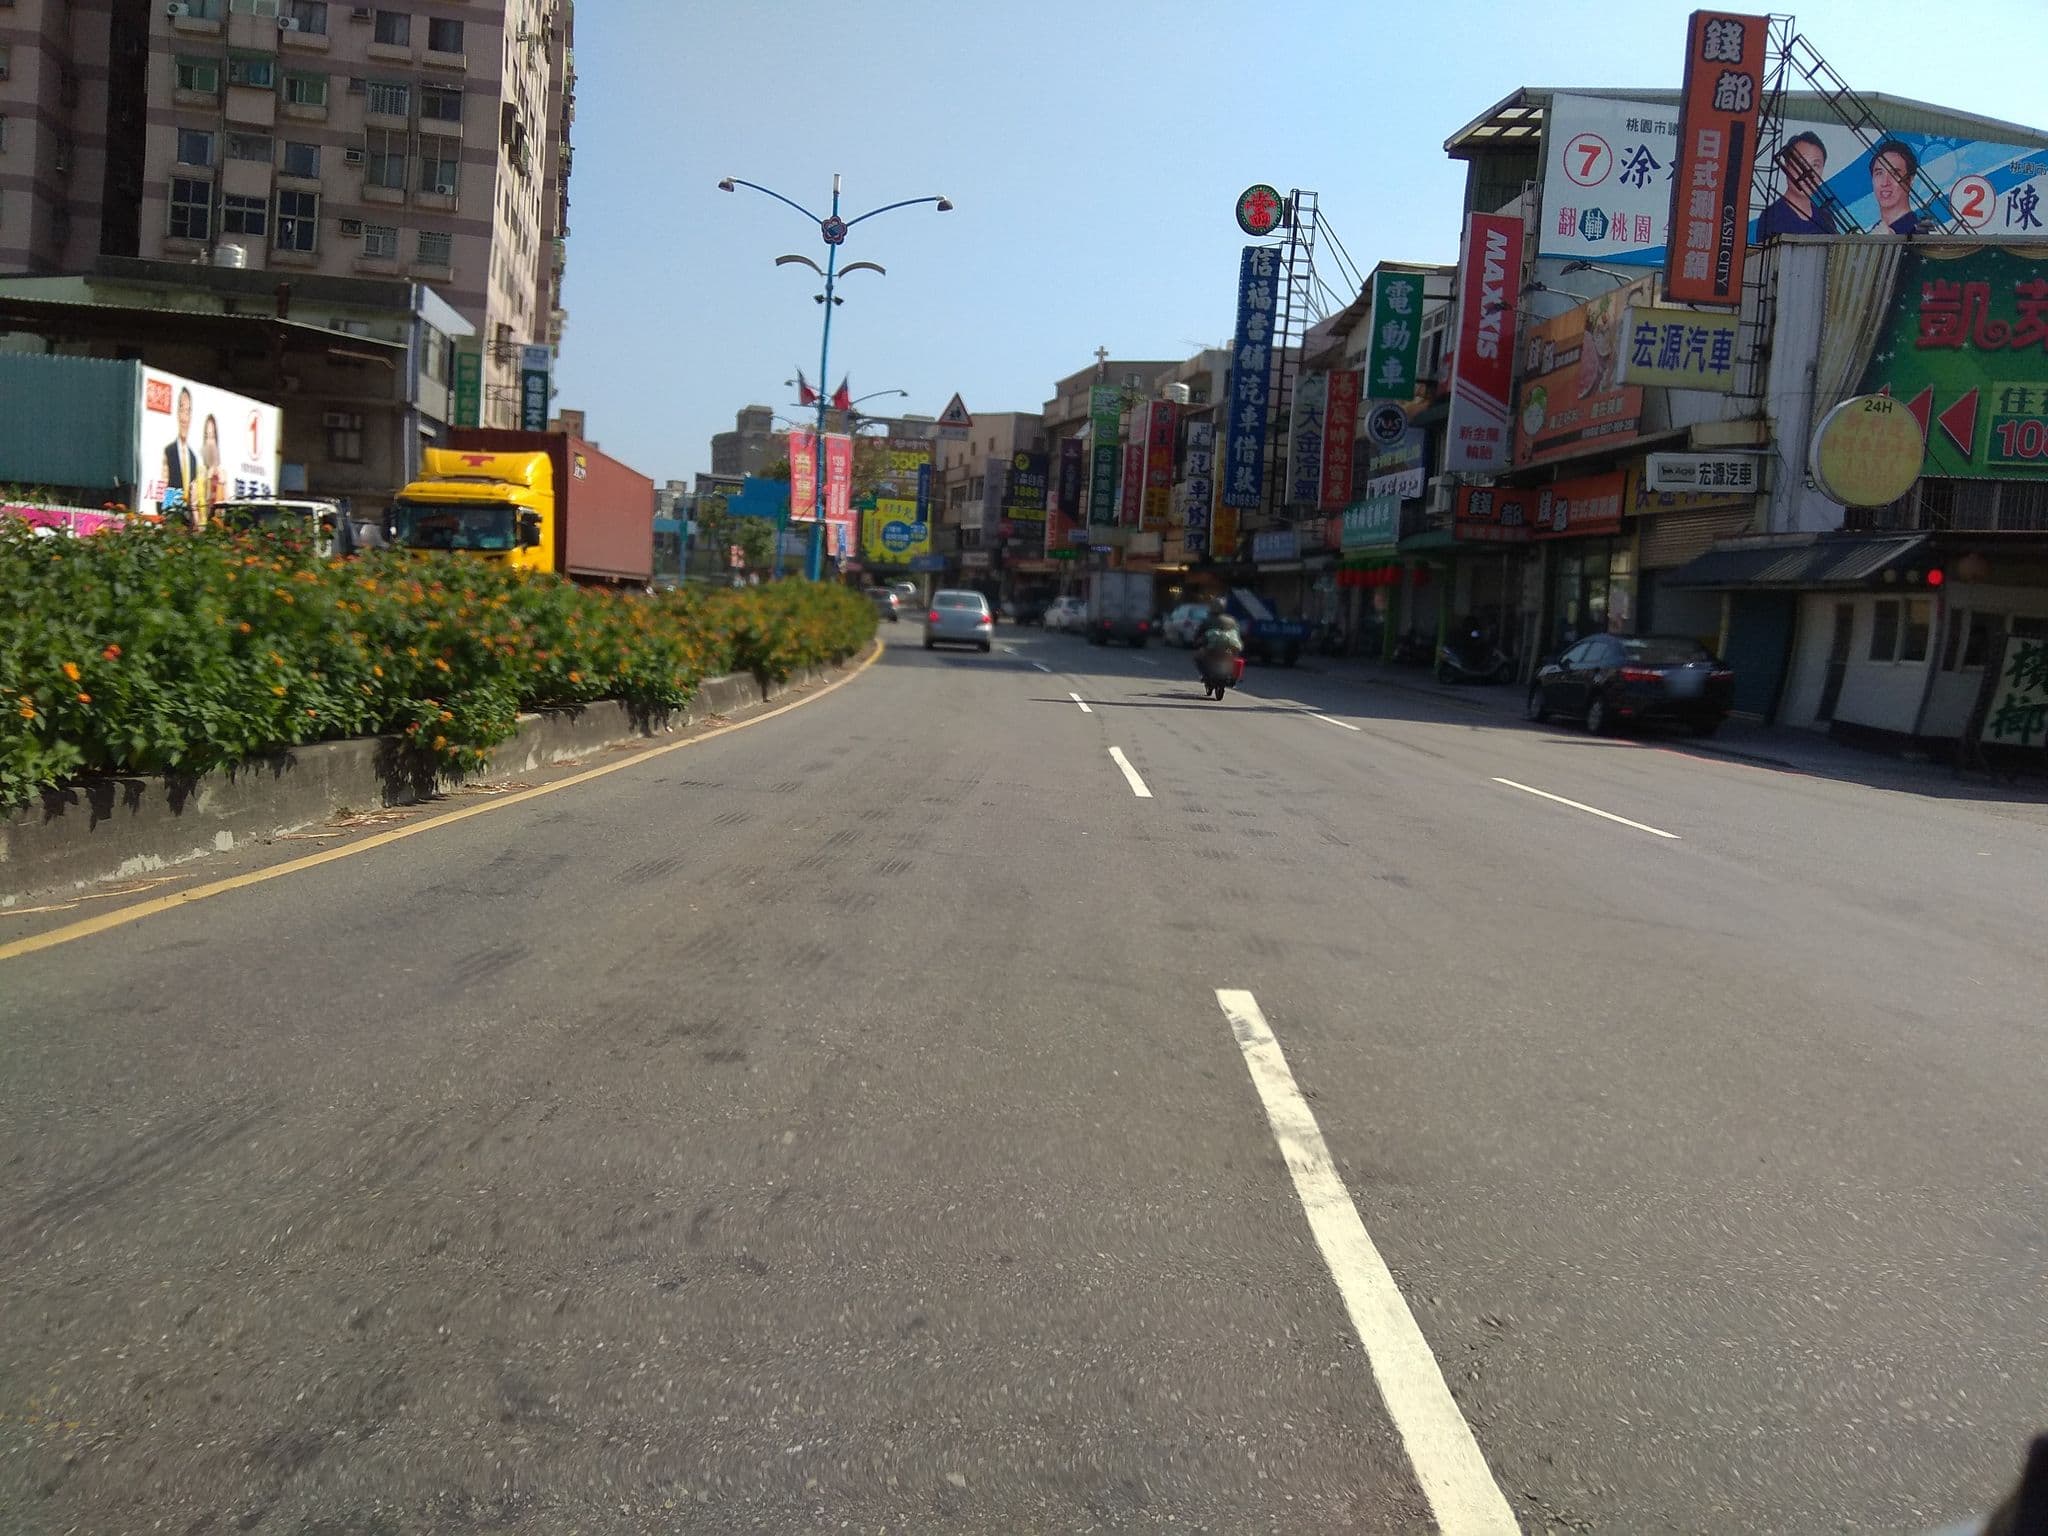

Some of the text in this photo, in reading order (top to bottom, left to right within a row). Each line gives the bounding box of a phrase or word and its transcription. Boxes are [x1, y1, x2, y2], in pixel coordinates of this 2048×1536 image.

[1703, 19, 1753, 113] 錢都
[1578, 144, 1602, 177] 7
[1619, 143, 1677, 190] 涂
[1961, 184, 1986, 218] 2
[2005, 184, 2044, 231] 陳
[1716, 203, 1736, 288] CASH CITY
[1475, 228, 1508, 360] MAXXIS
[1376, 279, 1415, 390] 電動車
[1631, 321, 1735, 375] 宏源汽車
[1864, 399, 1893, 414] 24H
[1996, 419, 2048, 459] 10
[1698, 461, 1753, 486] 宏源汽車
